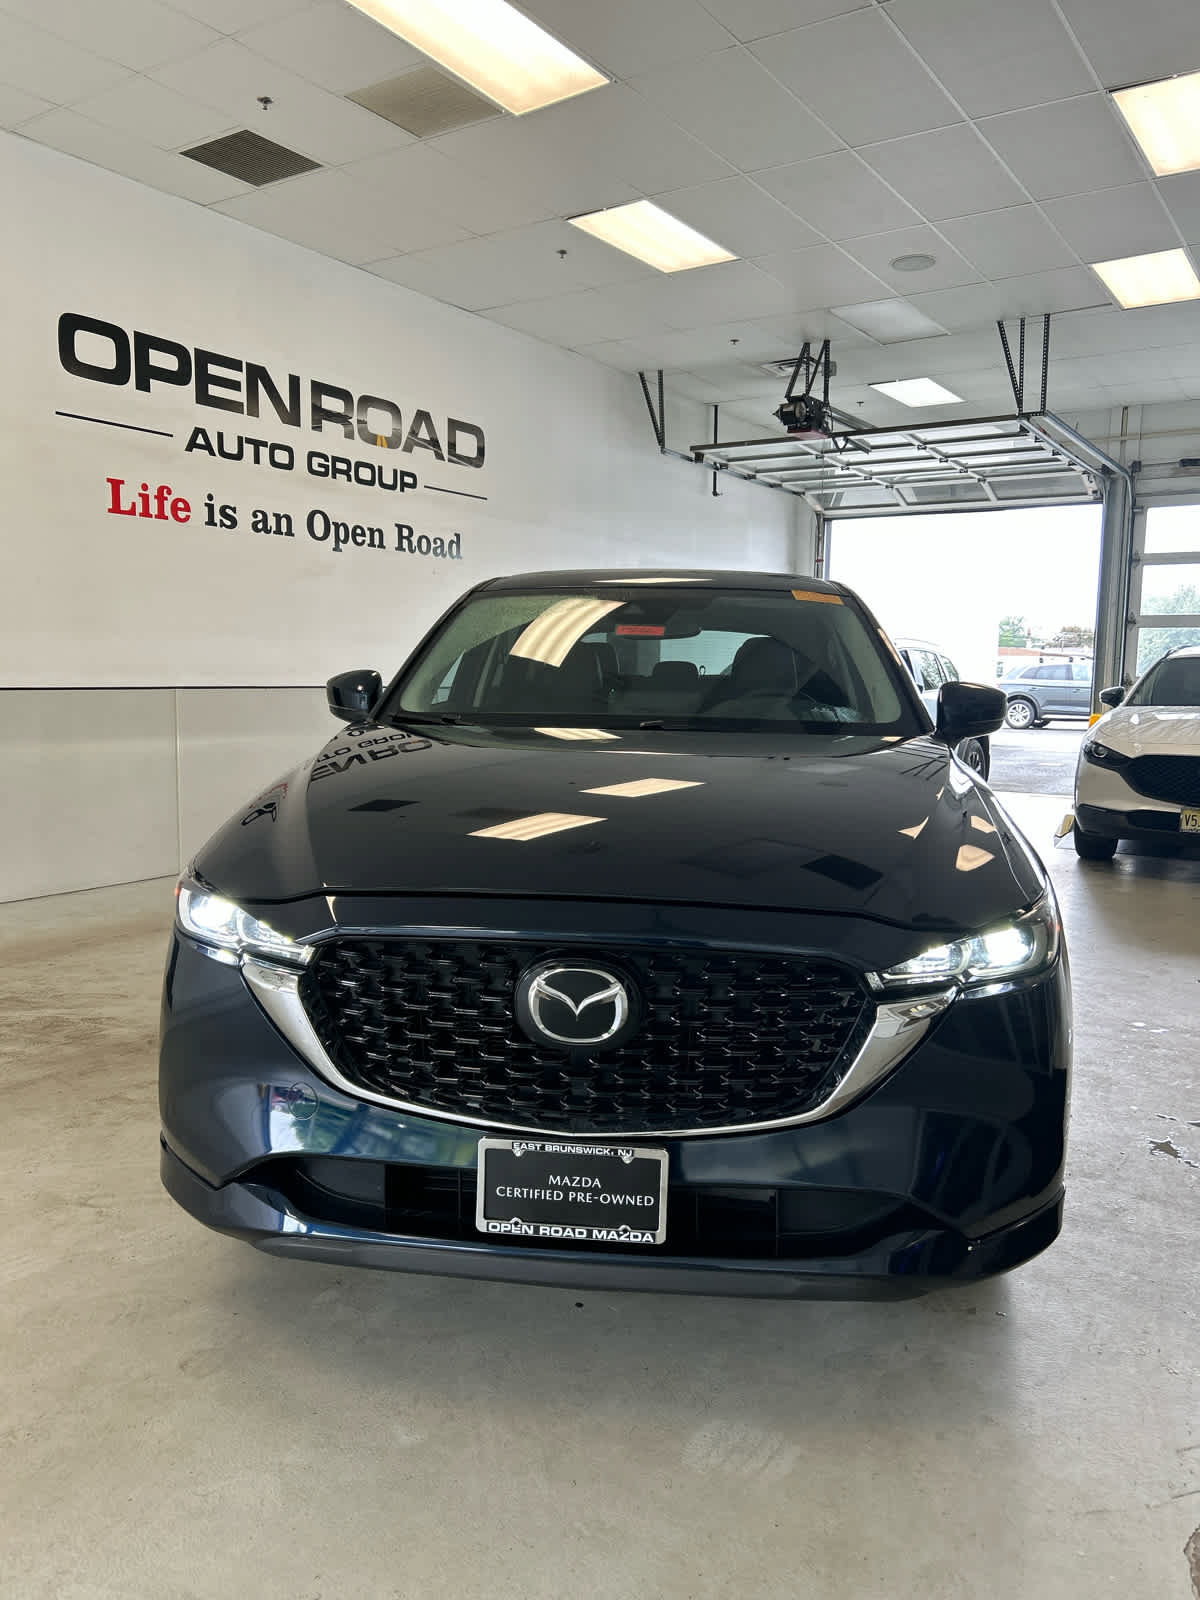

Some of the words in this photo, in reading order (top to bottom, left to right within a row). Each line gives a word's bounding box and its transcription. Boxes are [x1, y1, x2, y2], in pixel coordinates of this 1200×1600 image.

[58, 312, 301, 428] OPEN
[310, 379, 486, 469] ROAD
[184, 426, 295, 471] AUTO
[306, 450, 418, 493] GROUP
[105, 476, 192, 524] Life
[203, 493, 238, 530] is
[250, 507, 295, 538] an
[306, 509, 386, 552] Open
[394, 523, 463, 560] Road
[1185, 814, 1200, 827] V5
[513, 1142, 542, 1151] EAST
[617, 1148, 633, 1157] NJ
[548, 1174, 602, 1189] MAZDA
[495, 1186, 564, 1201] CERTIFIED
[568, 1191, 655, 1207] PRE-OWNED
[488, 1222, 534, 1235] OPEN
[539, 1226, 588, 1239] ROAD
[592, 1229, 655, 1243] MAZDA
